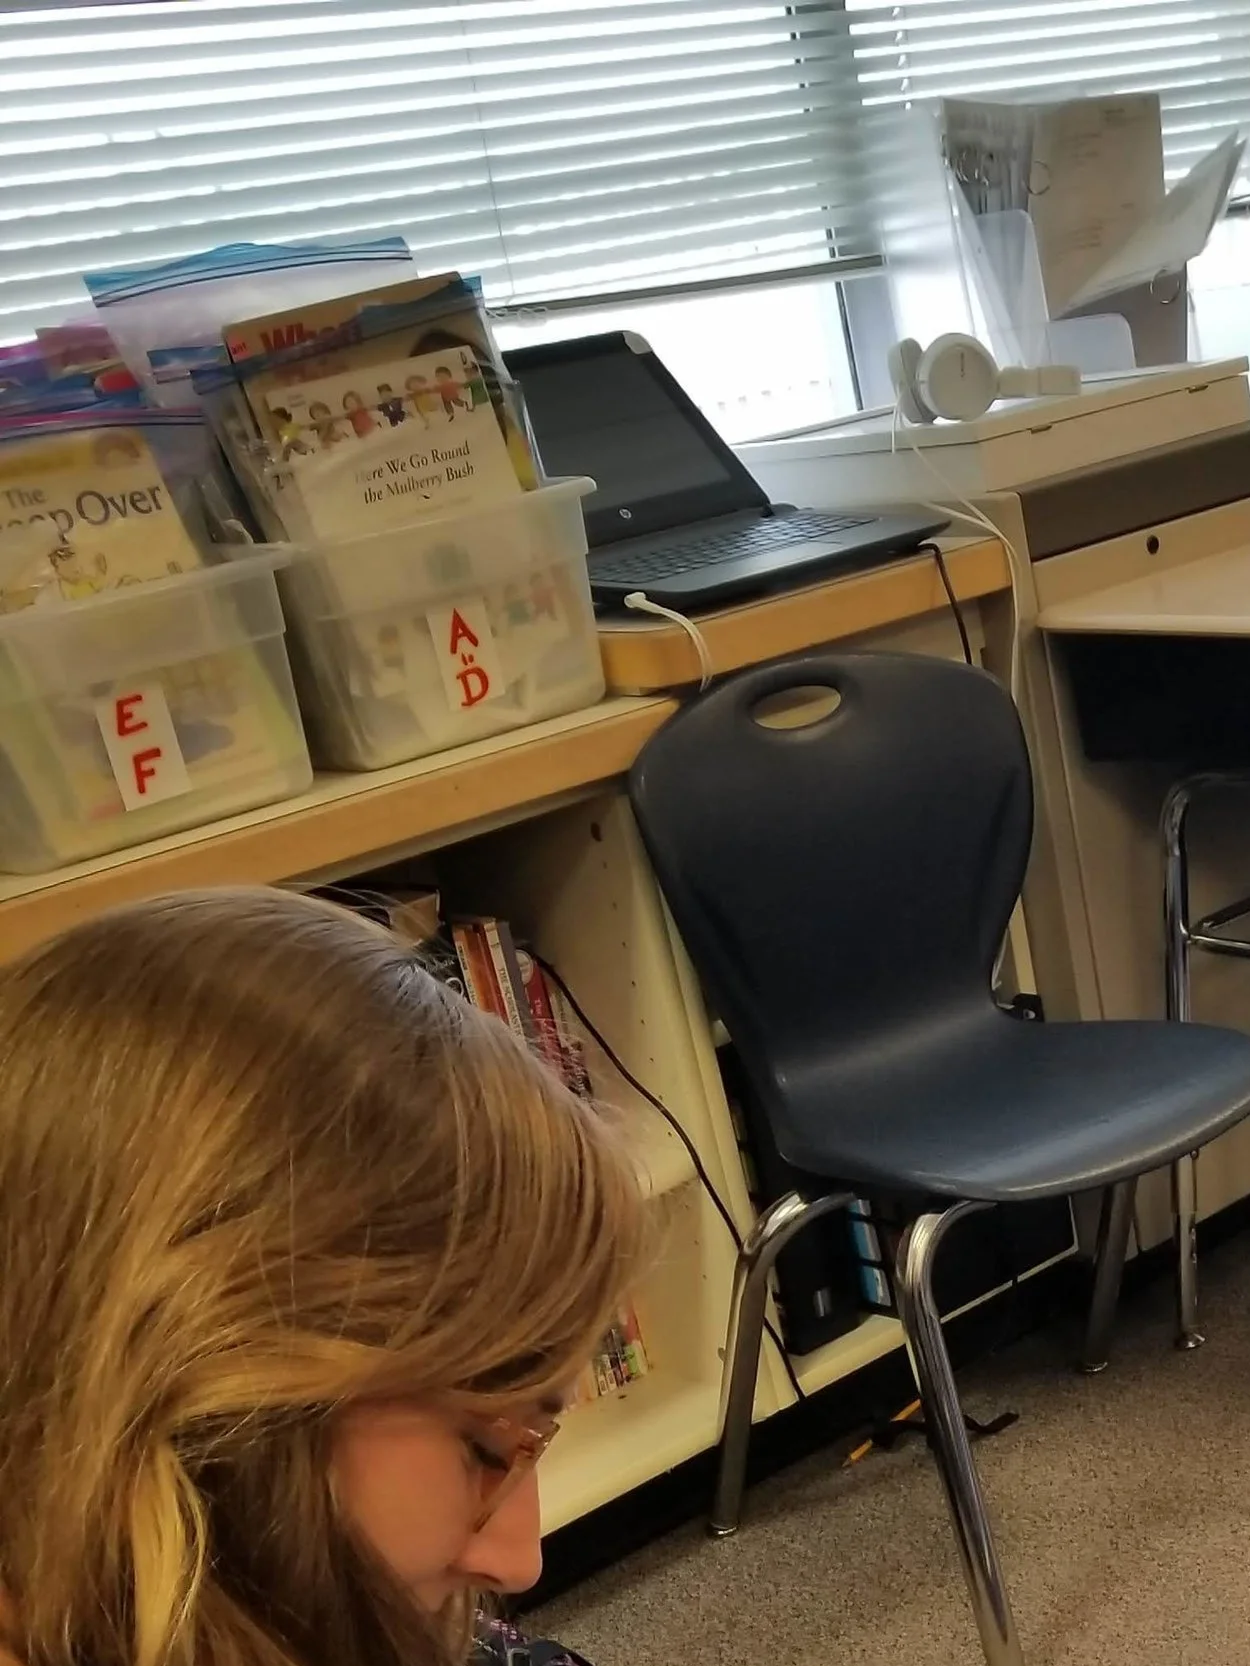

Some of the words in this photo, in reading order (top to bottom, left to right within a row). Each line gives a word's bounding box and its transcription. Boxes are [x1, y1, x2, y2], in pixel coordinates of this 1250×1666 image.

[385, 459, 407, 475] We
[409, 453, 429, 469] Go
[430, 440, 470, 463] Round
[3, 488, 48, 510] The
[364, 487, 383, 504] the
[386, 474, 442, 496] Mulberry
[445, 461, 474, 481] Bush
[75, 484, 163, 525] Over
[449, 607, 480, 656] A
[455, 665, 490, 707] D
[115, 694, 148, 737] E
[132, 747, 161, 794] F
